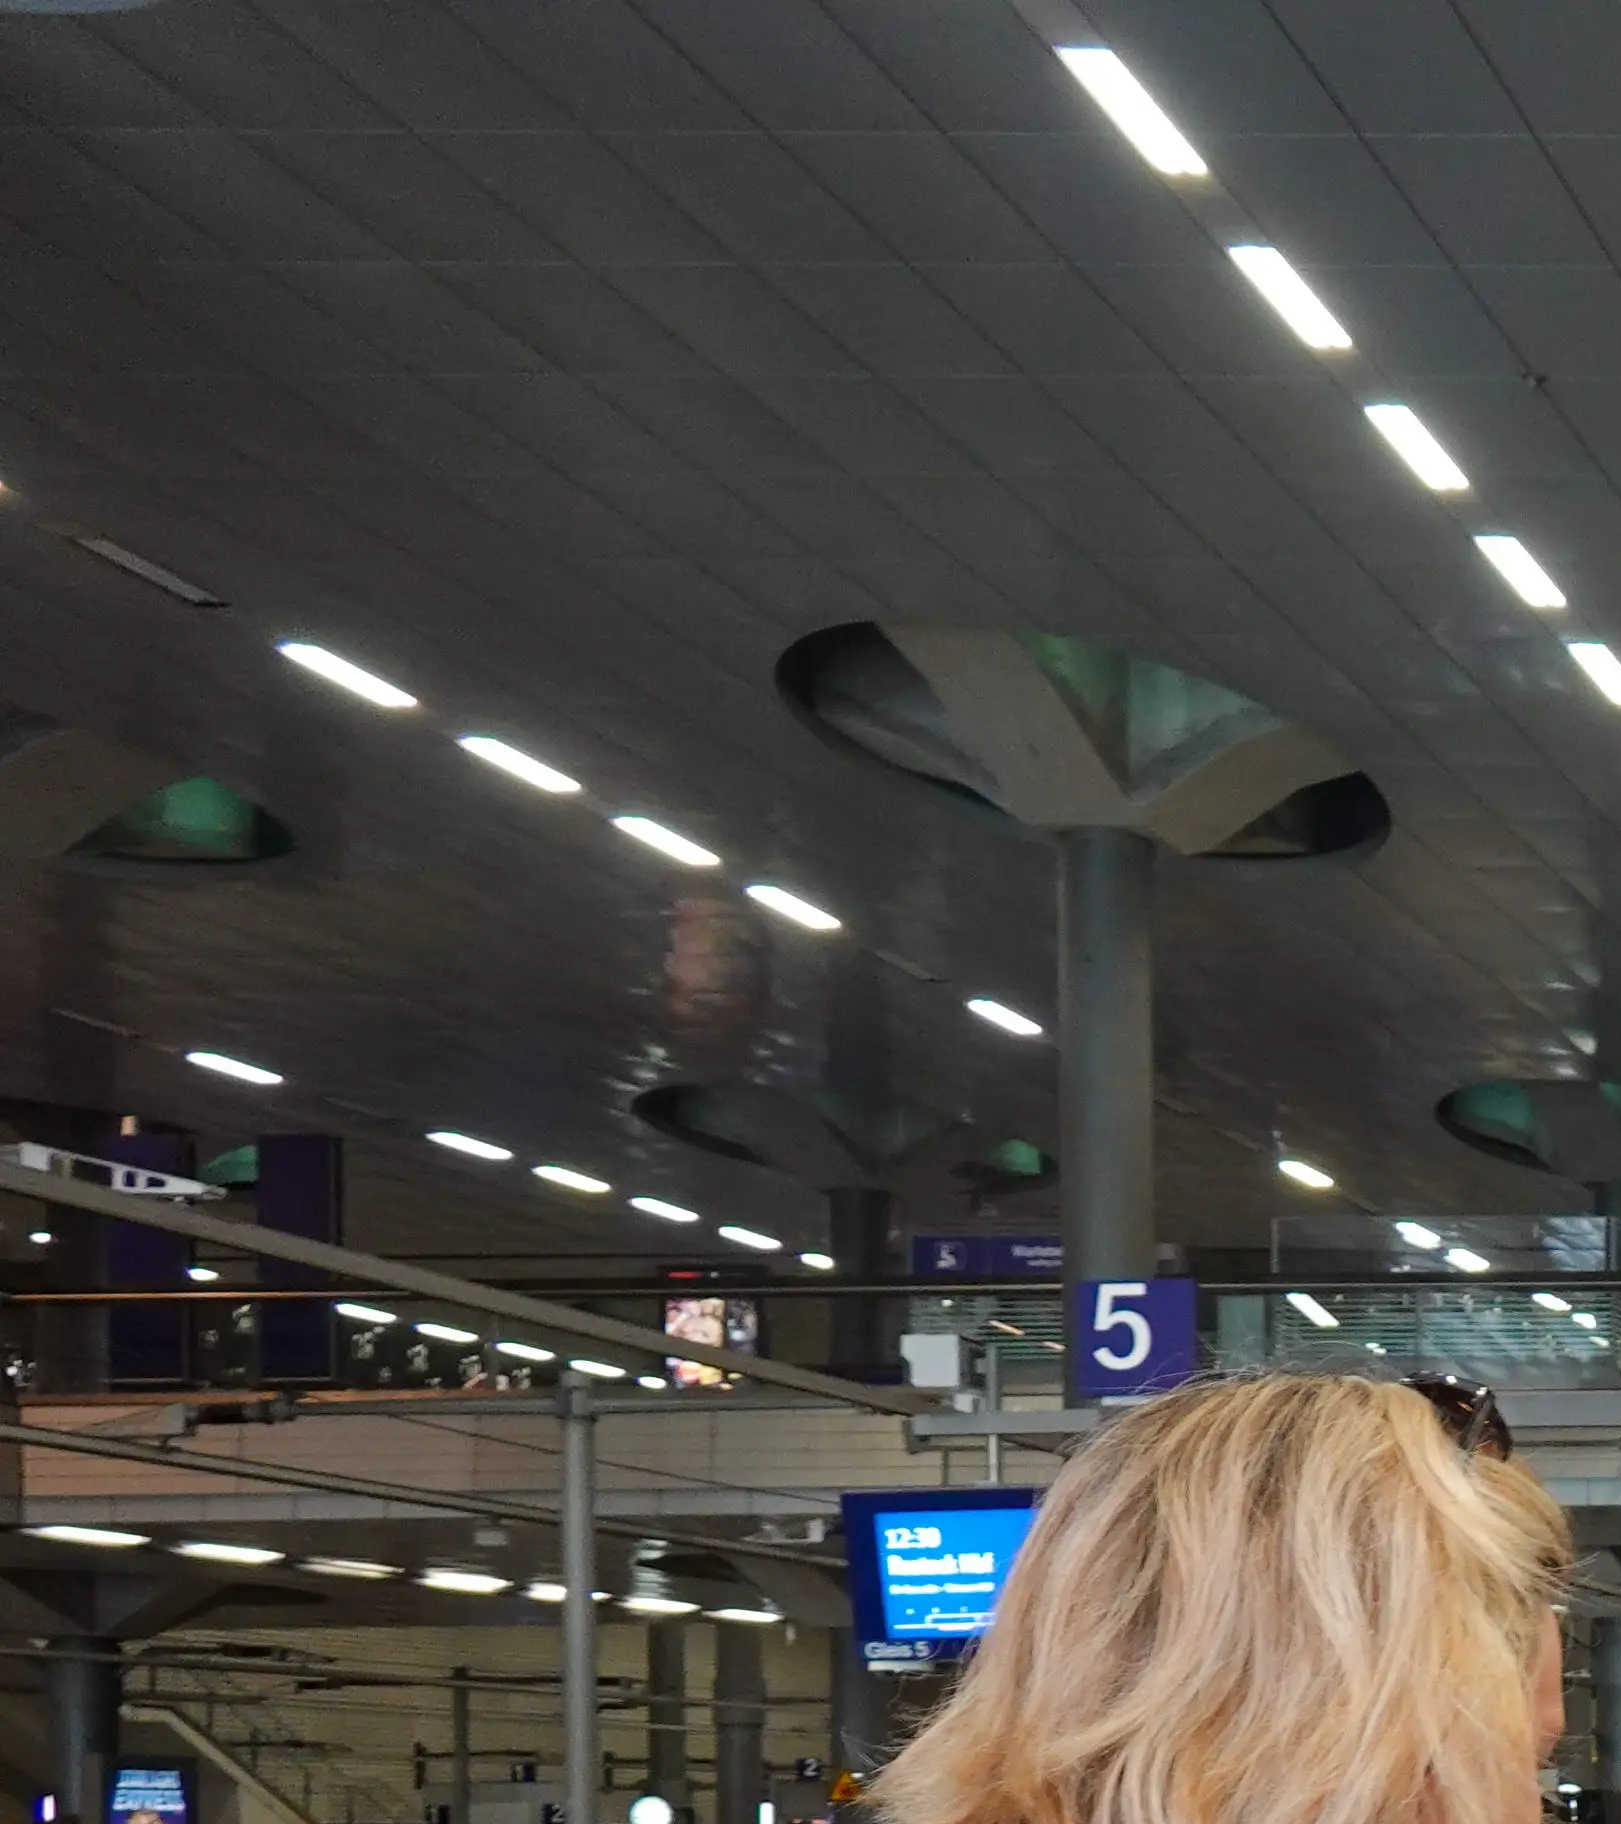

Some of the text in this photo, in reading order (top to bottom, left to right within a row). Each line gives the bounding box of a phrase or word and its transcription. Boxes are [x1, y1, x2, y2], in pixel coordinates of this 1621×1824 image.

[1092, 1282, 1152, 1370] 5
[864, 1641, 930, 1658] Gleis 5
[804, 1757, 819, 1777] 2
[551, 1803, 565, 1824] 2
